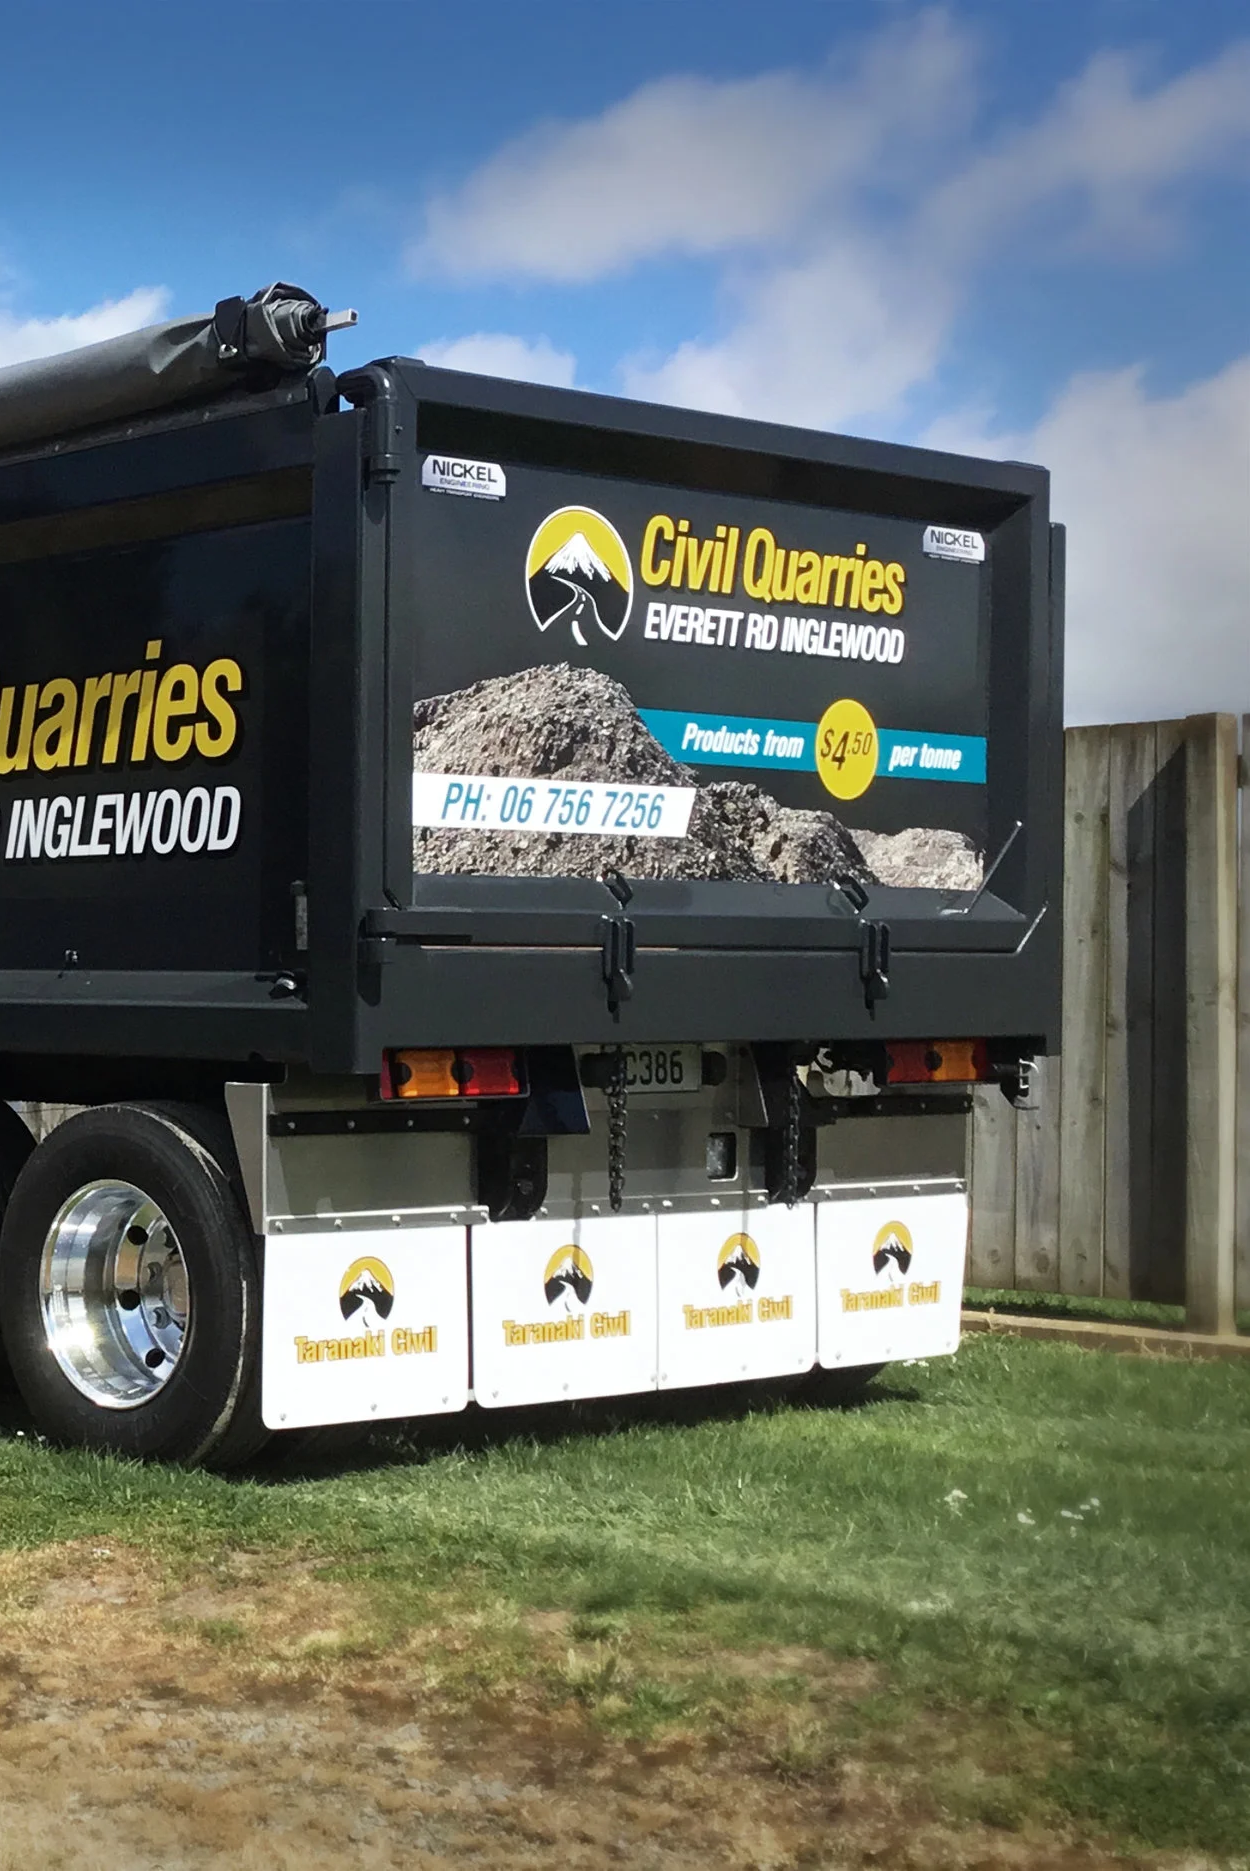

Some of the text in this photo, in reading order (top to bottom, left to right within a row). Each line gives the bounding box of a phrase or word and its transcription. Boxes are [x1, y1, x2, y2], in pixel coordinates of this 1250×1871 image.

[432, 459, 497, 483] NICKEL
[439, 478, 490, 490] ENGINEERING
[930, 529, 978, 549] NICKEL
[640, 514, 905, 616] Civil Quarries
[644, 601, 905, 664] EVERETT RD INGLEWOOD
[681, 722, 759, 758] Products
[763, 734, 804, 759] from
[888, 745, 918, 772] per
[919, 743, 962, 771] tonne
[5, 786, 241, 860] INGLEWOOD
[441, 783, 665, 830] PH: 06 756 7256
[683, 1295, 794, 1330] Taranaki Civil
[840, 1281, 942, 1313] Taranaki Civil
[294, 1325, 439, 1364] Taranaki Civil
[502, 1310, 632, 1347] Taranaki Civil
